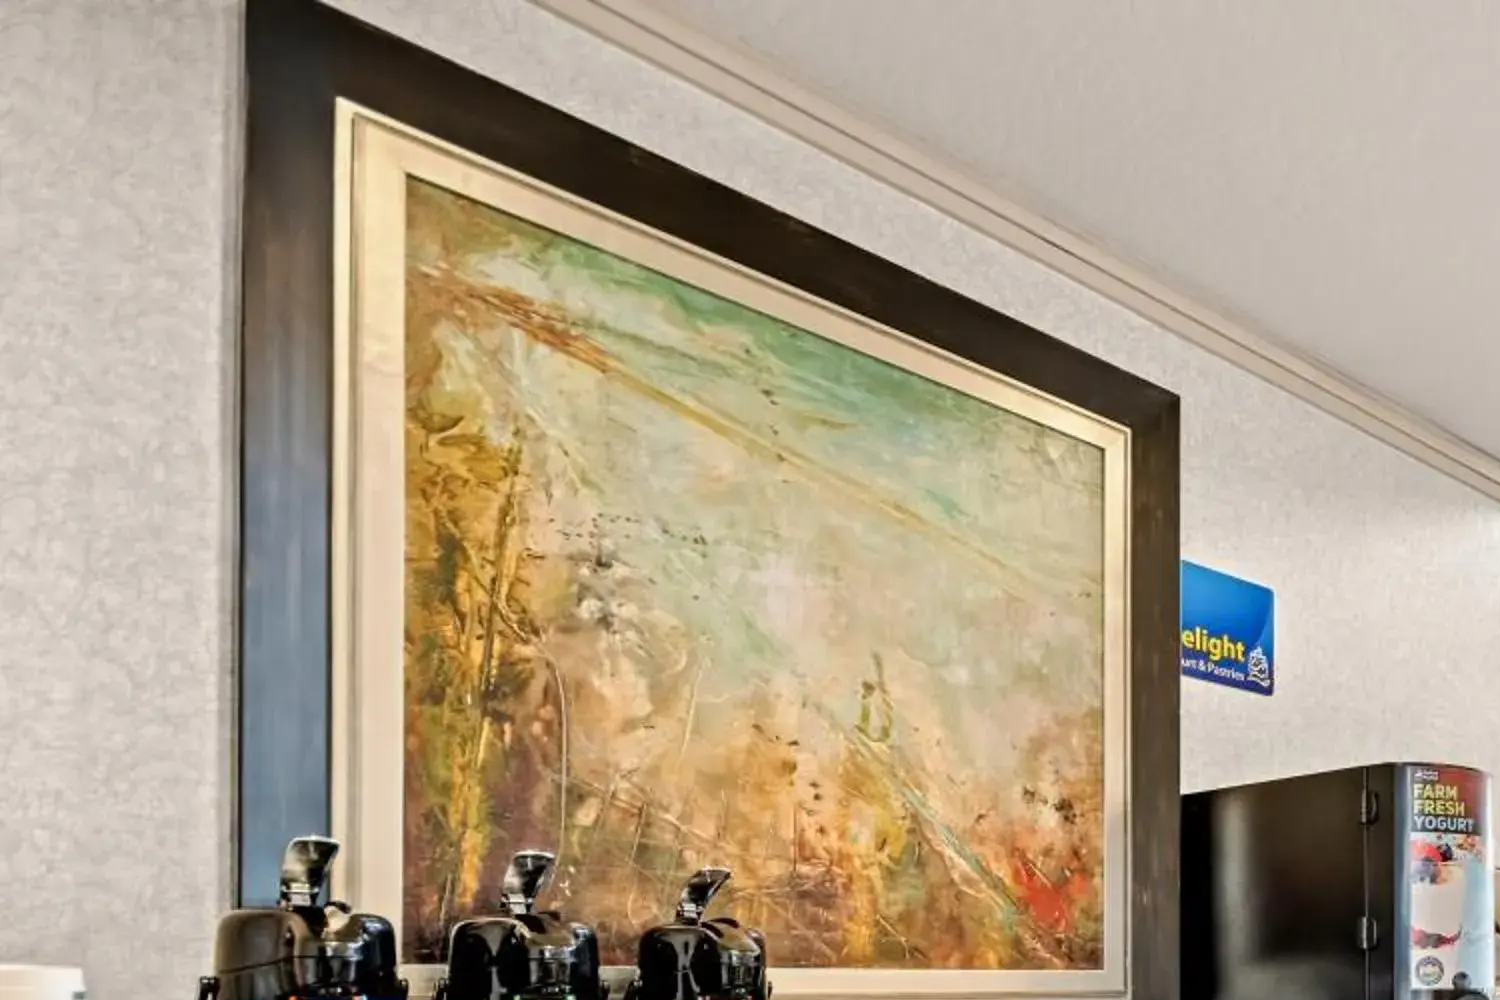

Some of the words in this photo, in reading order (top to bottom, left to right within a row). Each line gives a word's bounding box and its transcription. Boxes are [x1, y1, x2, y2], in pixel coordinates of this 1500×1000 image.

[1208, 661, 1245, 682] Pastries
[1414, 783, 1458, 800] FARM
[1414, 799, 1465, 816] FRESH
[1414, 815, 1473, 832] YOGURT
